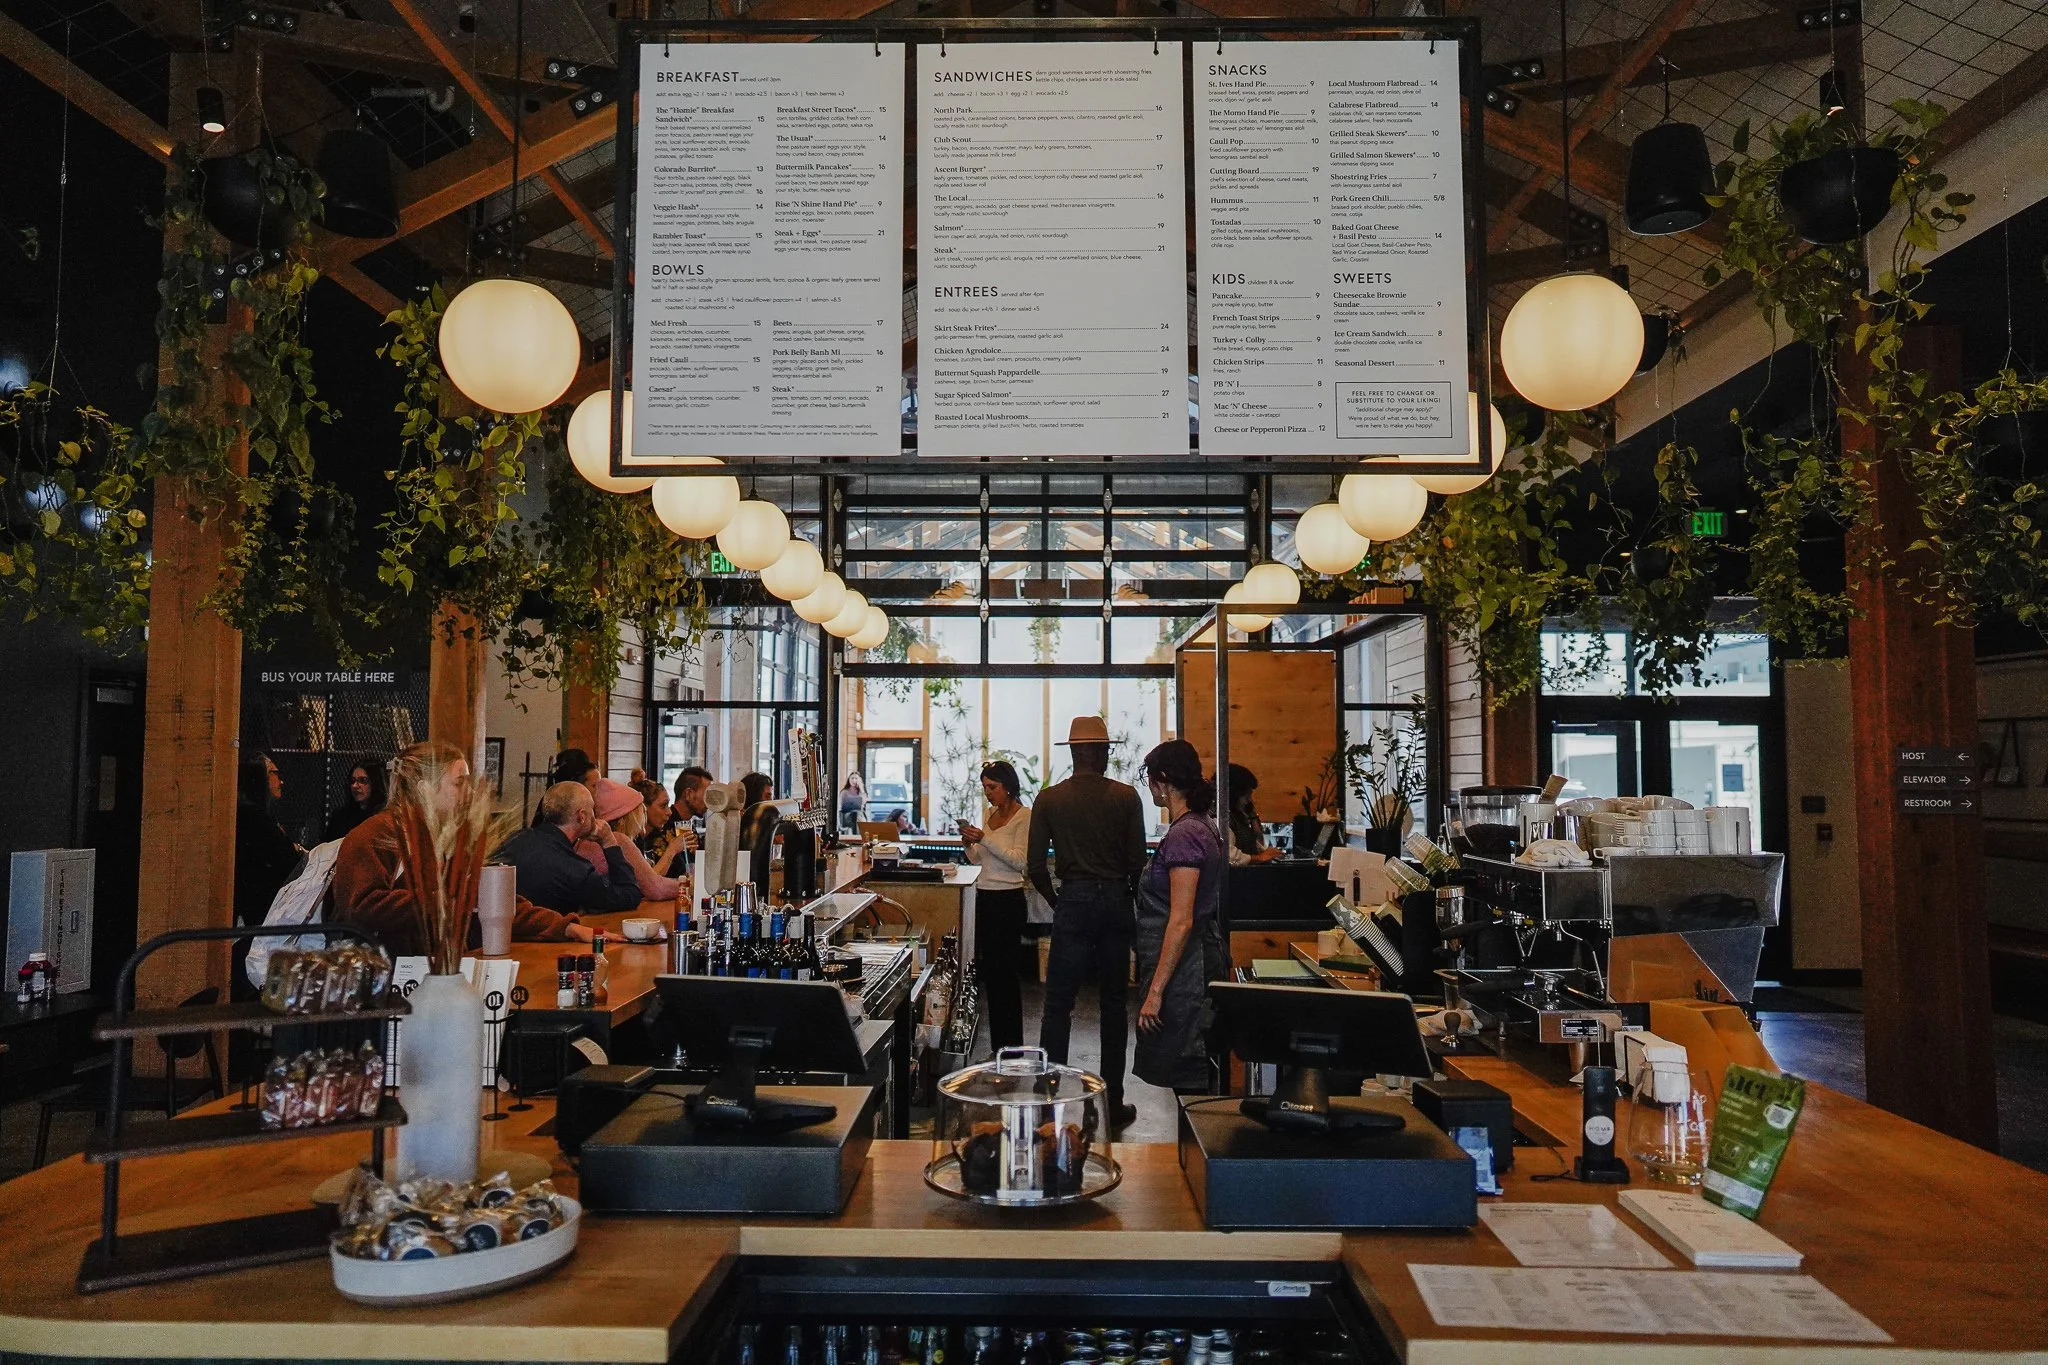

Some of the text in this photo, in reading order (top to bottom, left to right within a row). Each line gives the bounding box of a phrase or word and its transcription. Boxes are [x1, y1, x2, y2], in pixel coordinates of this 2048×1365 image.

[1209, 64, 1267, 76] SNACKS
[657, 71, 739, 83] BREAKFAST
[934, 71, 1033, 83] SANDWICHES
[1328, 101, 1364, 109] Calabrese
[1230, 138, 1244, 146] Pop
[1209, 168, 1237, 176] Cutting
[1330, 173, 1369, 181] Shoestring
[1433, 194, 1445, 202] 5/8
[653, 204, 677, 212] Veggie
[652, 264, 704, 276] BOWLS
[1212, 273, 1246, 285] KIDS
[1333, 273, 1392, 284] SWEETS
[935, 286, 998, 298] ENTREES
[1259, 314, 1280, 322] Strips
[953, 324, 973, 332] Steak
[791, 349, 809, 357] Belly
[965, 347, 1002, 355] Agrodolce
[1243, 358, 1265, 367] Strips
[1334, 359, 1367, 367] Seasonal
[970, 369, 996, 378] Squash
[998, 369, 1041, 377] Pappardelle
[934, 392, 955, 400] Sugar
[956, 391, 980, 400] Spiced
[934, 413, 963, 421] Roasted
[965, 413, 984, 421] Local
[1250, 426, 1286, 434] Pepperoni
[1287, 425, 1307, 433] Pizza
[1694, 512, 1723, 535] EXIT
[261, 672, 395, 682] BUS YOUR TABLE HERE
[1902, 752, 1926, 760] HOST
[1903, 775, 1946, 784] ELEVATOR
[1904, 799, 1951, 807] RESTROOM
